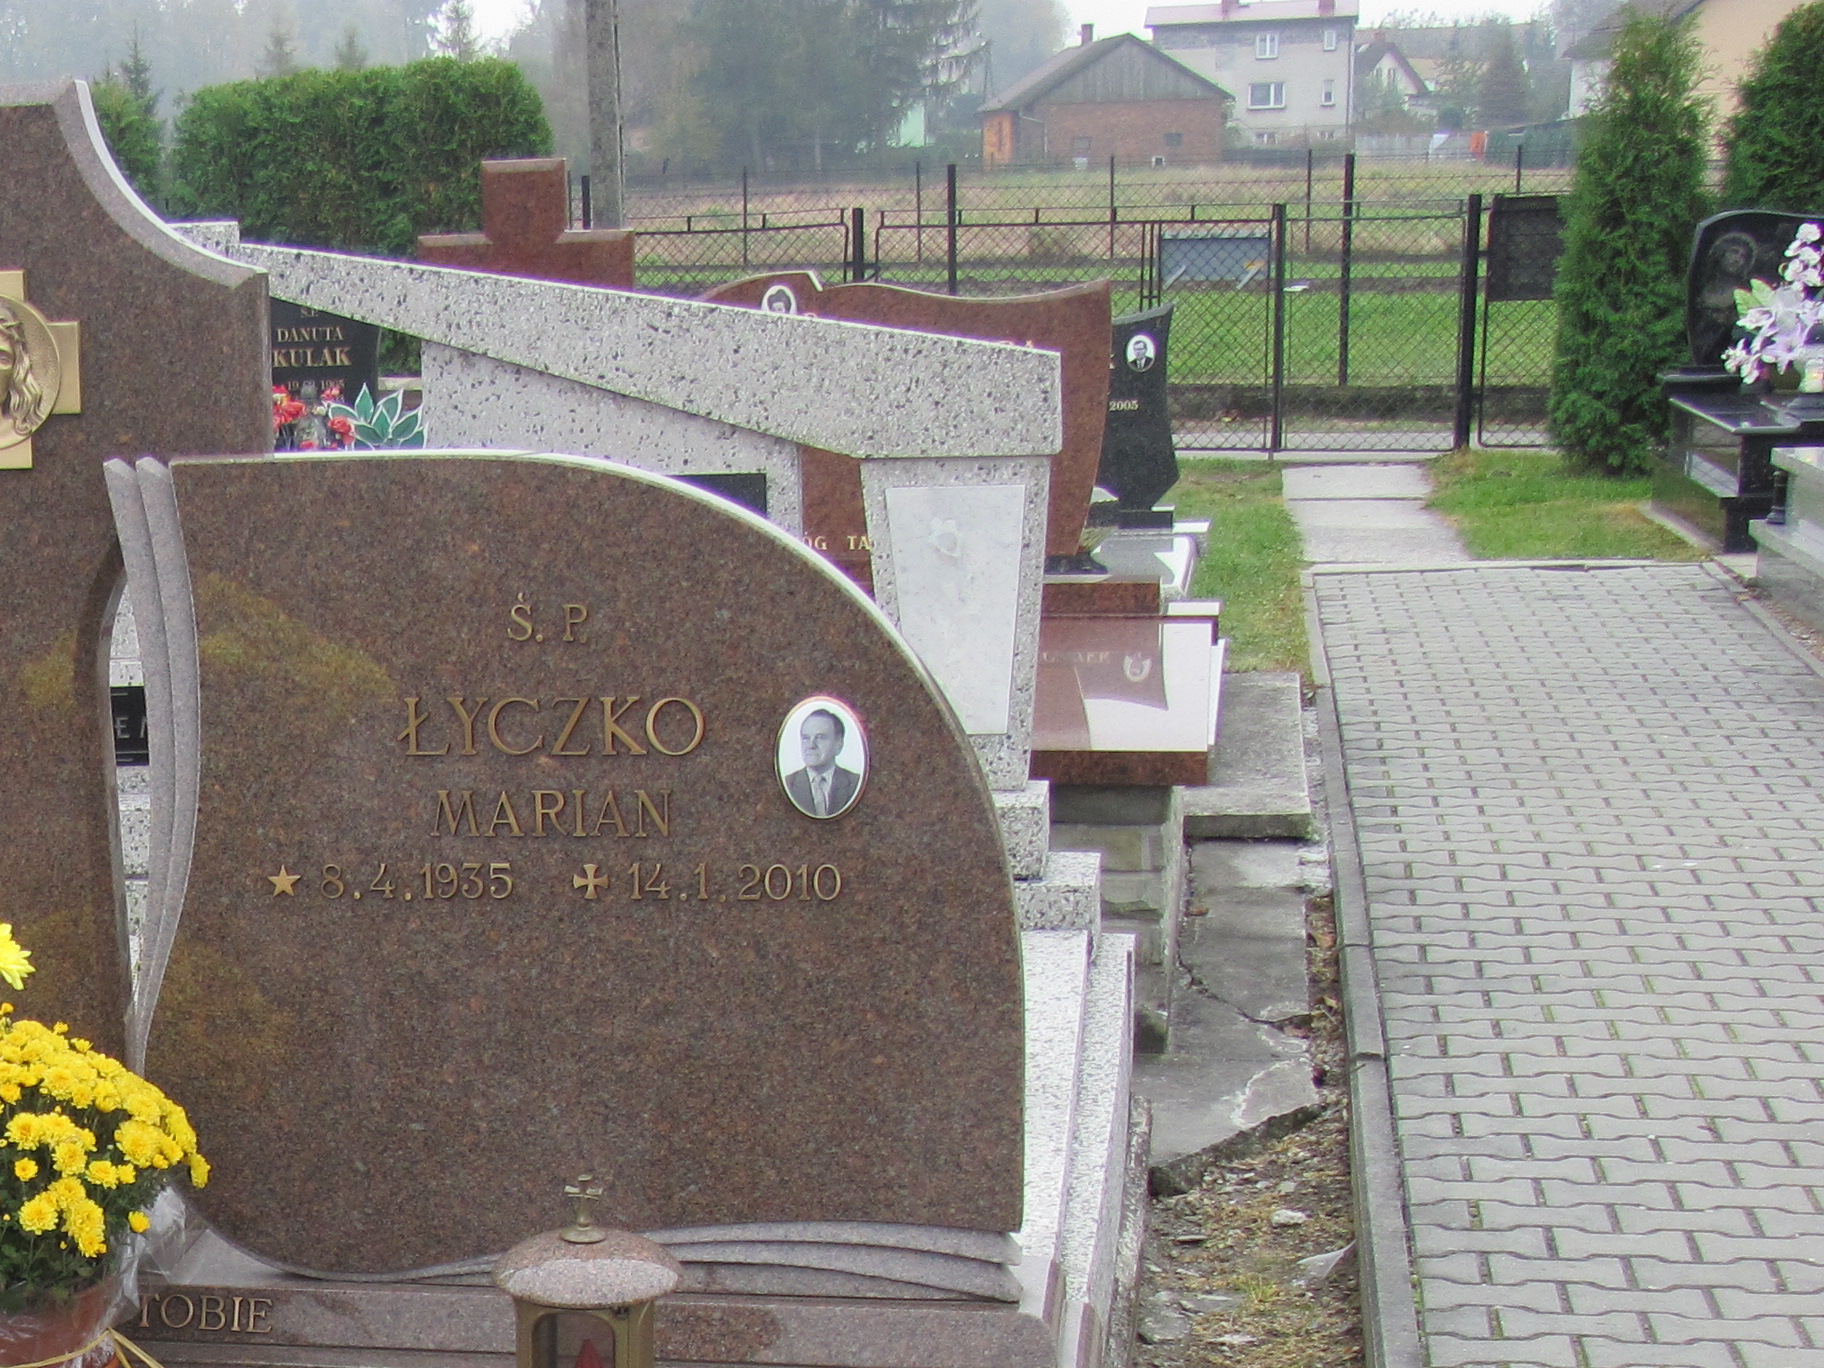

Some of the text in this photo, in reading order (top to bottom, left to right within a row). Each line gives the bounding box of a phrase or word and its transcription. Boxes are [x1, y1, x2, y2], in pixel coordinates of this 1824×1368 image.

[277, 326, 344, 342] DANUTA
[397, 696, 706, 756] ŁYCZKO
[430, 789, 673, 838] MARIAN
[139, 1292, 273, 1334] TOBIE
